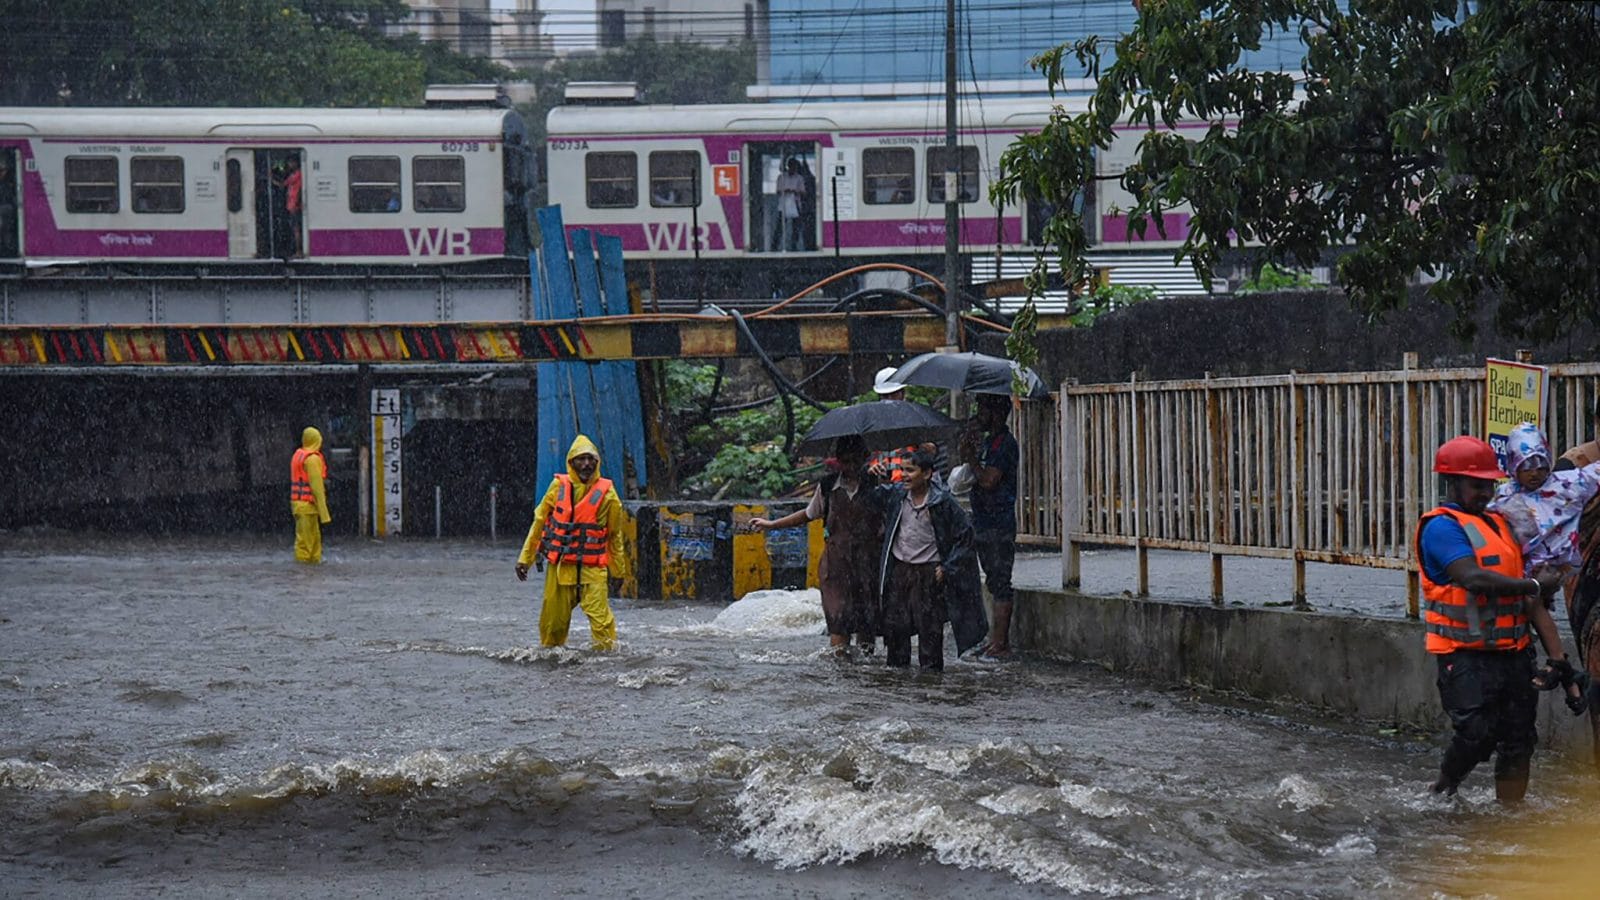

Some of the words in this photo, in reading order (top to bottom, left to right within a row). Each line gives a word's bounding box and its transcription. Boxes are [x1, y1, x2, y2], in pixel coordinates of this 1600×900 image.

[551, 141, 589, 151] 6073A
[879, 135, 920, 145] WESTERN
[922, 135, 947, 145] RAILW
[79, 145, 121, 153] WESTERN
[129, 145, 166, 153] RAILWAY
[441, 142, 479, 152] 6073B
[1489, 368, 1522, 399] Ratan
[1489, 395, 1537, 426] Heritage
[390, 416, 399, 428] 7
[391, 436, 400, 450] 6
[1490, 438, 1507, 455] SPA
[391, 460, 399, 473] 5
[391, 482, 400, 495] 4
[392, 507, 400, 521] 3
